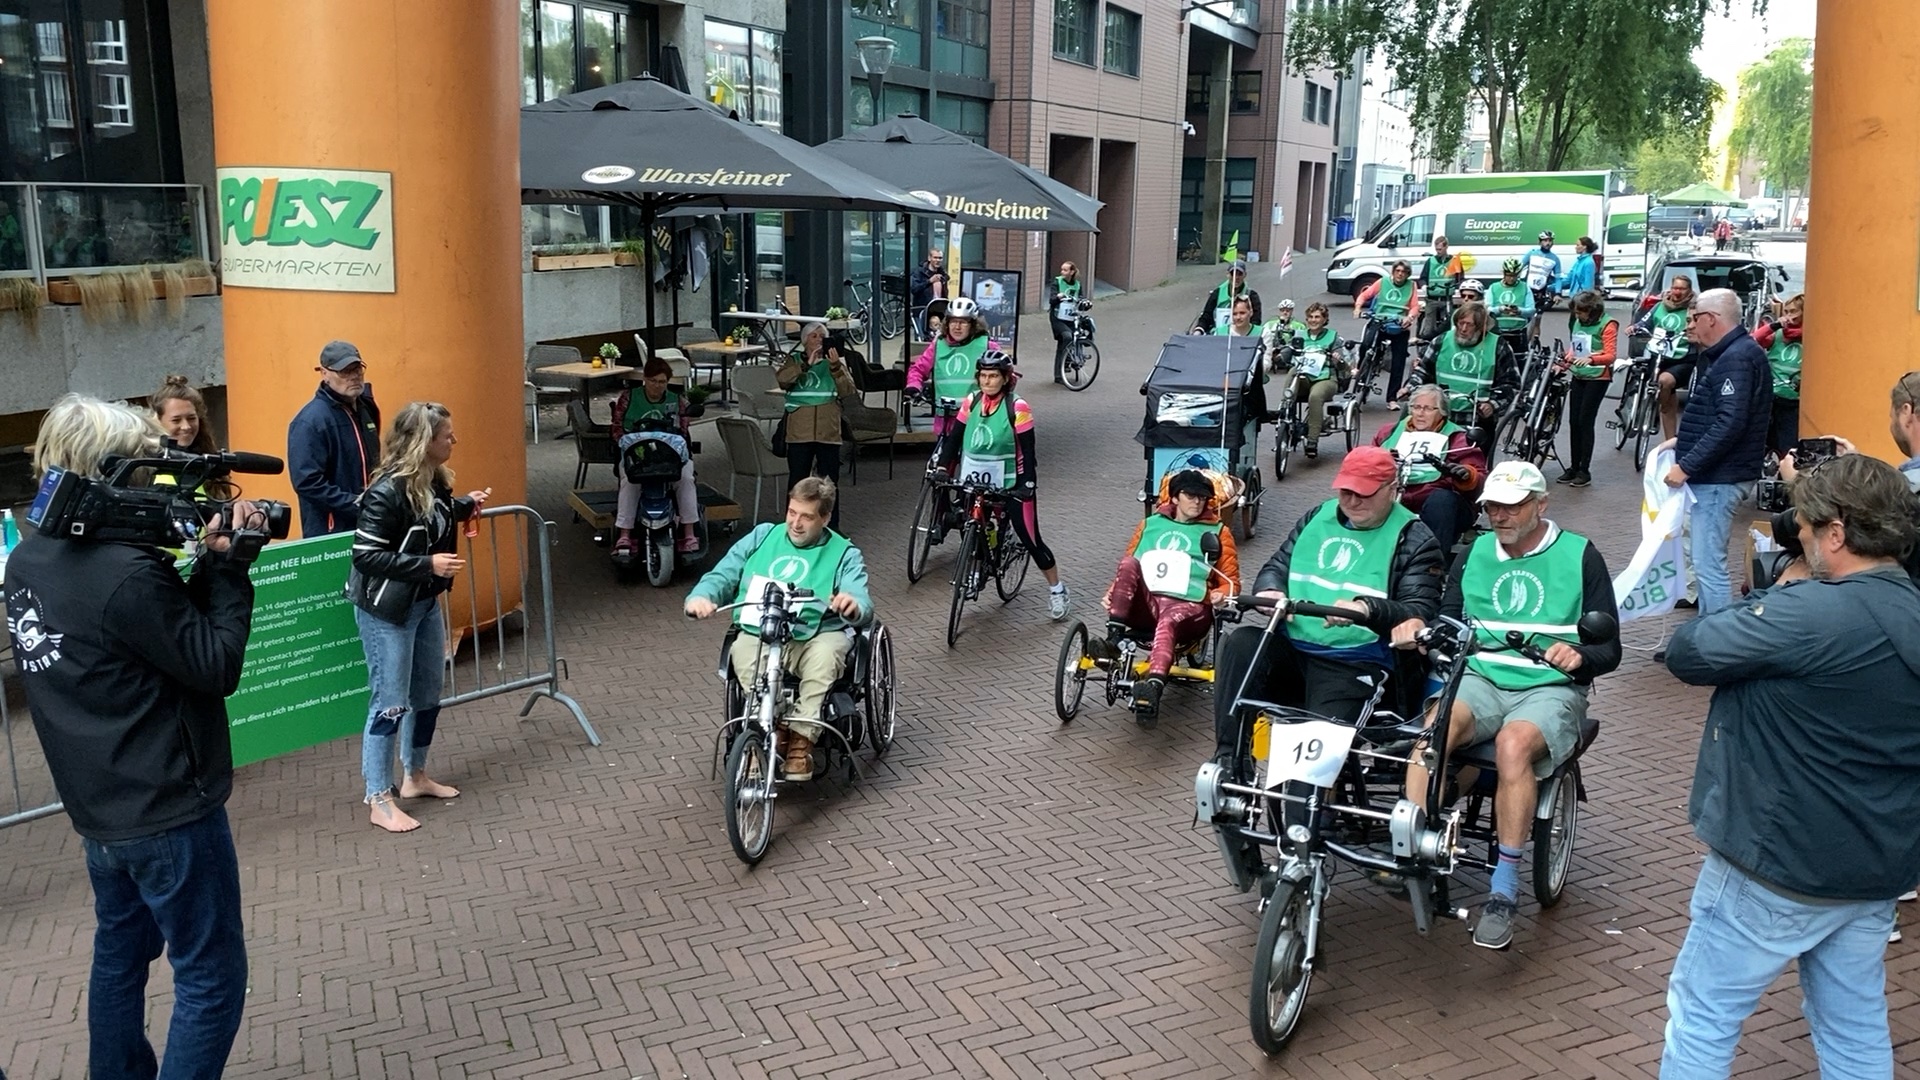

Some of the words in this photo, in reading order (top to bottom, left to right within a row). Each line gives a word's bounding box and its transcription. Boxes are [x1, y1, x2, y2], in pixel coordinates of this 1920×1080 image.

[638, 167, 792, 187] Warsteiner
[221, 177, 383, 250] POIESZ
[944, 194, 1051, 221] Warsteiner
[1464, 218, 1523, 233] Europcar
[1463, 234, 1488, 242] moving
[223, 258, 382, 277] SUPERMARKTEN
[1532, 279, 1542, 287] 16
[1571, 341, 1583, 353] 14
[1409, 441, 1430, 455] 15
[971, 470, 992, 486] 30
[260, 562, 280, 573] met
[280, 557, 300, 569] NEE
[301, 554, 322, 565] kunt
[1156, 562, 1168, 579] 9
[252, 571, 298, 587] enement:
[265, 603, 273, 611] 14
[274, 600, 297, 609] dagen
[297, 593, 326, 604] klachten
[326, 590, 339, 598] van
[283, 606, 306, 616] koorts
[252, 616, 298, 633] smaakverlies?
[245, 641, 262, 652] sitief
[263, 637, 285, 649] getest
[286, 635, 296, 643] op
[297, 627, 322, 640] corona?
[243, 659, 257, 668] den
[258, 657, 266, 665] in
[266, 651, 292, 662] contact
[293, 644, 321, 658] geweest
[321, 641, 336, 650] met
[336, 638, 349, 646] een
[249, 684, 263, 692] een
[264, 679, 279, 689] land
[280, 672, 308, 686] geweest
[309, 669, 323, 678] met
[323, 664, 345, 674] oranje
[345, 660, 353, 669] of
[256, 663, 281, 676] partner
[232, 718, 246, 727] dan
[247, 712, 266, 723] dient
[272, 706, 287, 716] zich
[295, 699, 320, 710] melden
[320, 694, 330, 704] bij
[330, 693, 339, 701] de
[1292, 738, 1324, 765] 19
